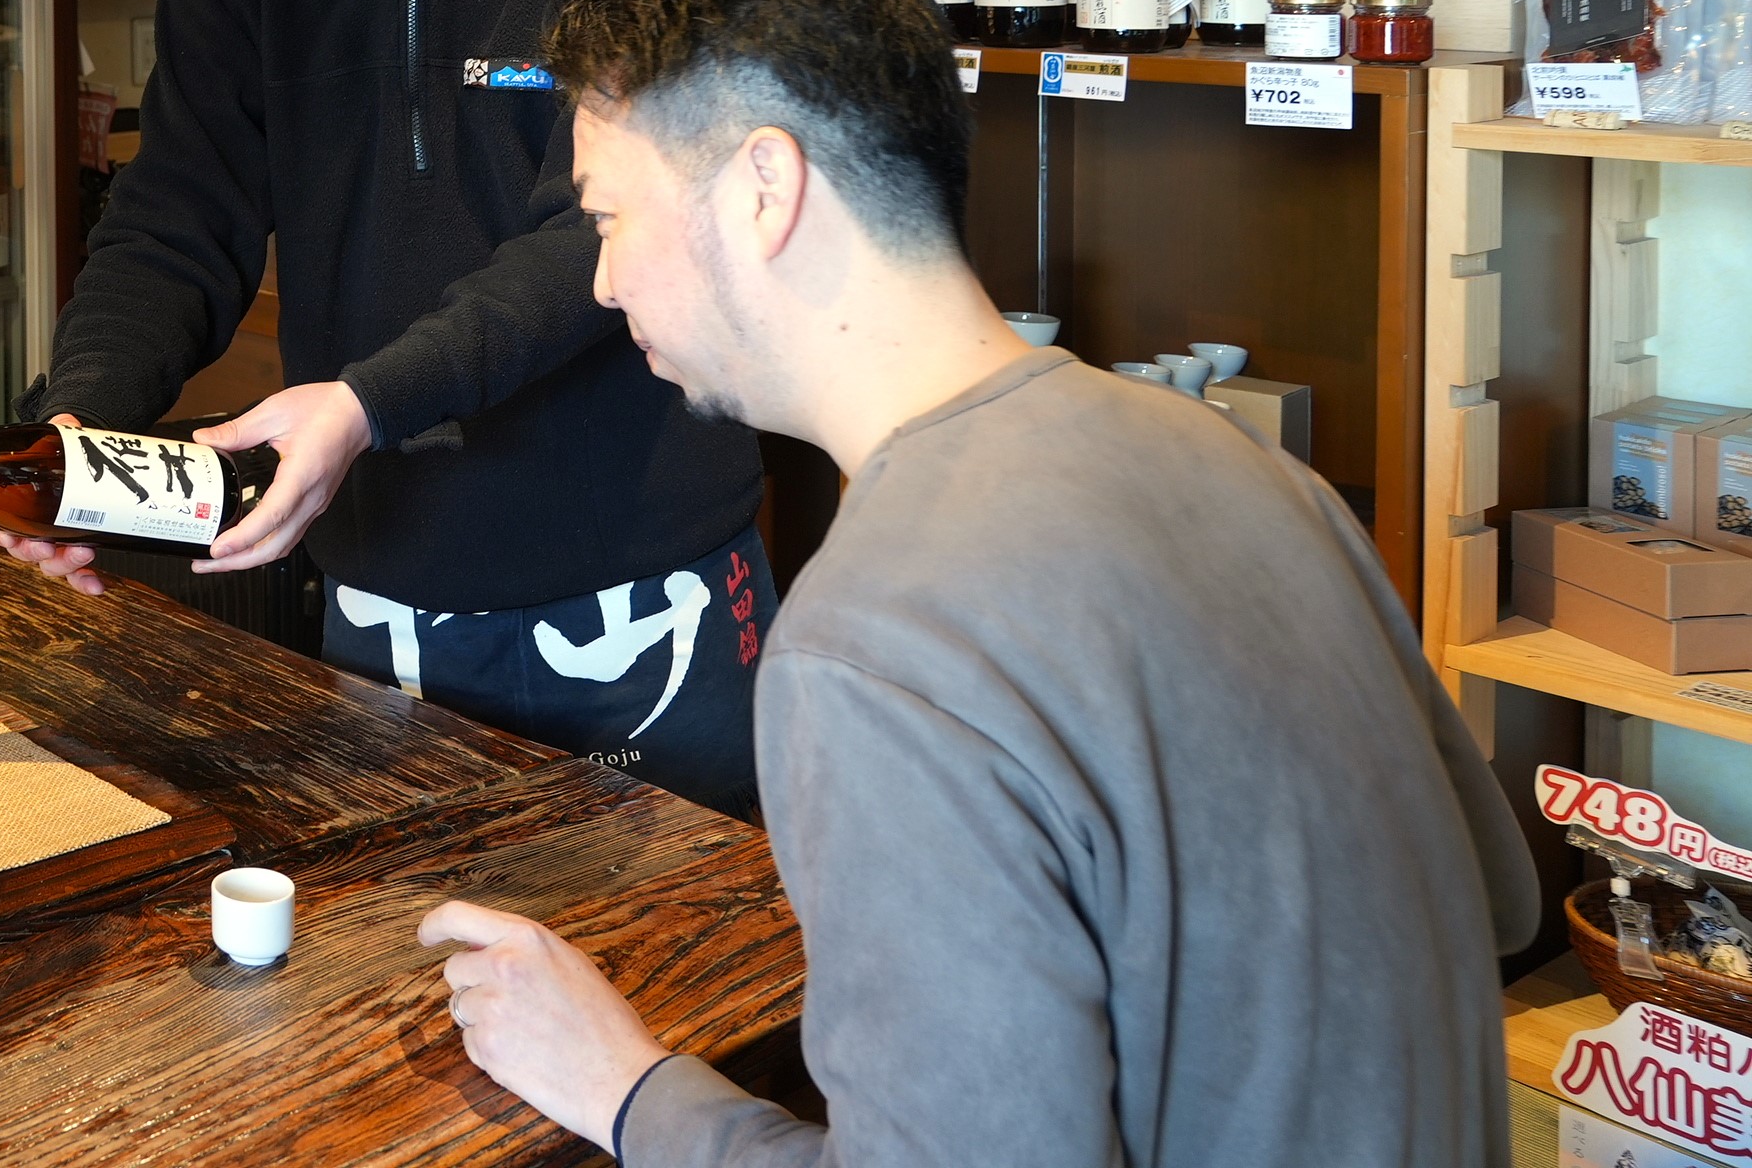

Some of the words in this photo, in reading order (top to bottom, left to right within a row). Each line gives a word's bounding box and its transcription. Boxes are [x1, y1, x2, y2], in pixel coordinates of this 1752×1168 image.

[497, 74, 545, 84] KAVU
[1251, 88, 1301, 104] ¥702
[1536, 86, 1586, 99] ¥598
[725, 550, 759, 668] 山田錦
[589, 749, 642, 767] Goju
